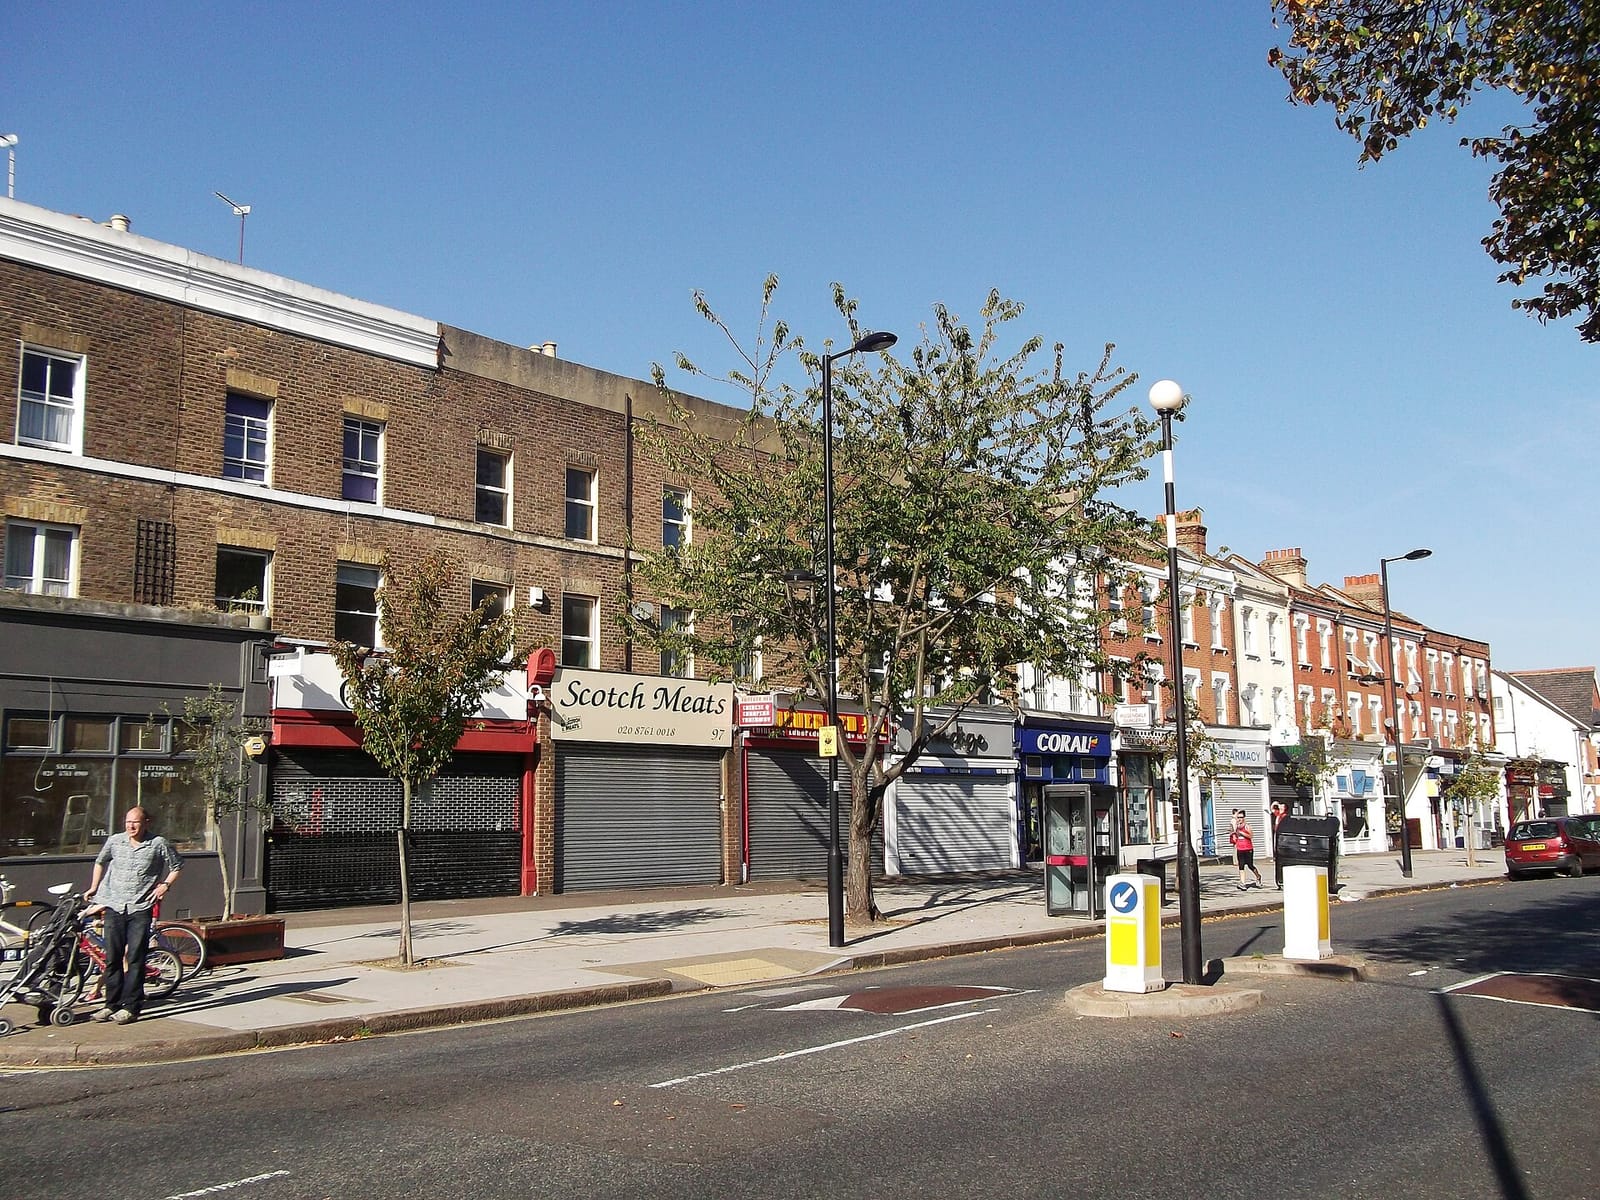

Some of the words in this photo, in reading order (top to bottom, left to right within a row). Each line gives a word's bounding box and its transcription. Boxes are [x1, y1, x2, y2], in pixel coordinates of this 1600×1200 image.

[560, 680, 646, 710] Scotch
[652, 685, 727, 715] Meats
[617, 726, 633, 736] 020
[634, 727, 654, 737] 8761
[655, 728, 677, 738] 0018
[711, 728, 726, 742] 97
[1037, 733, 1091, 754] CORAL
